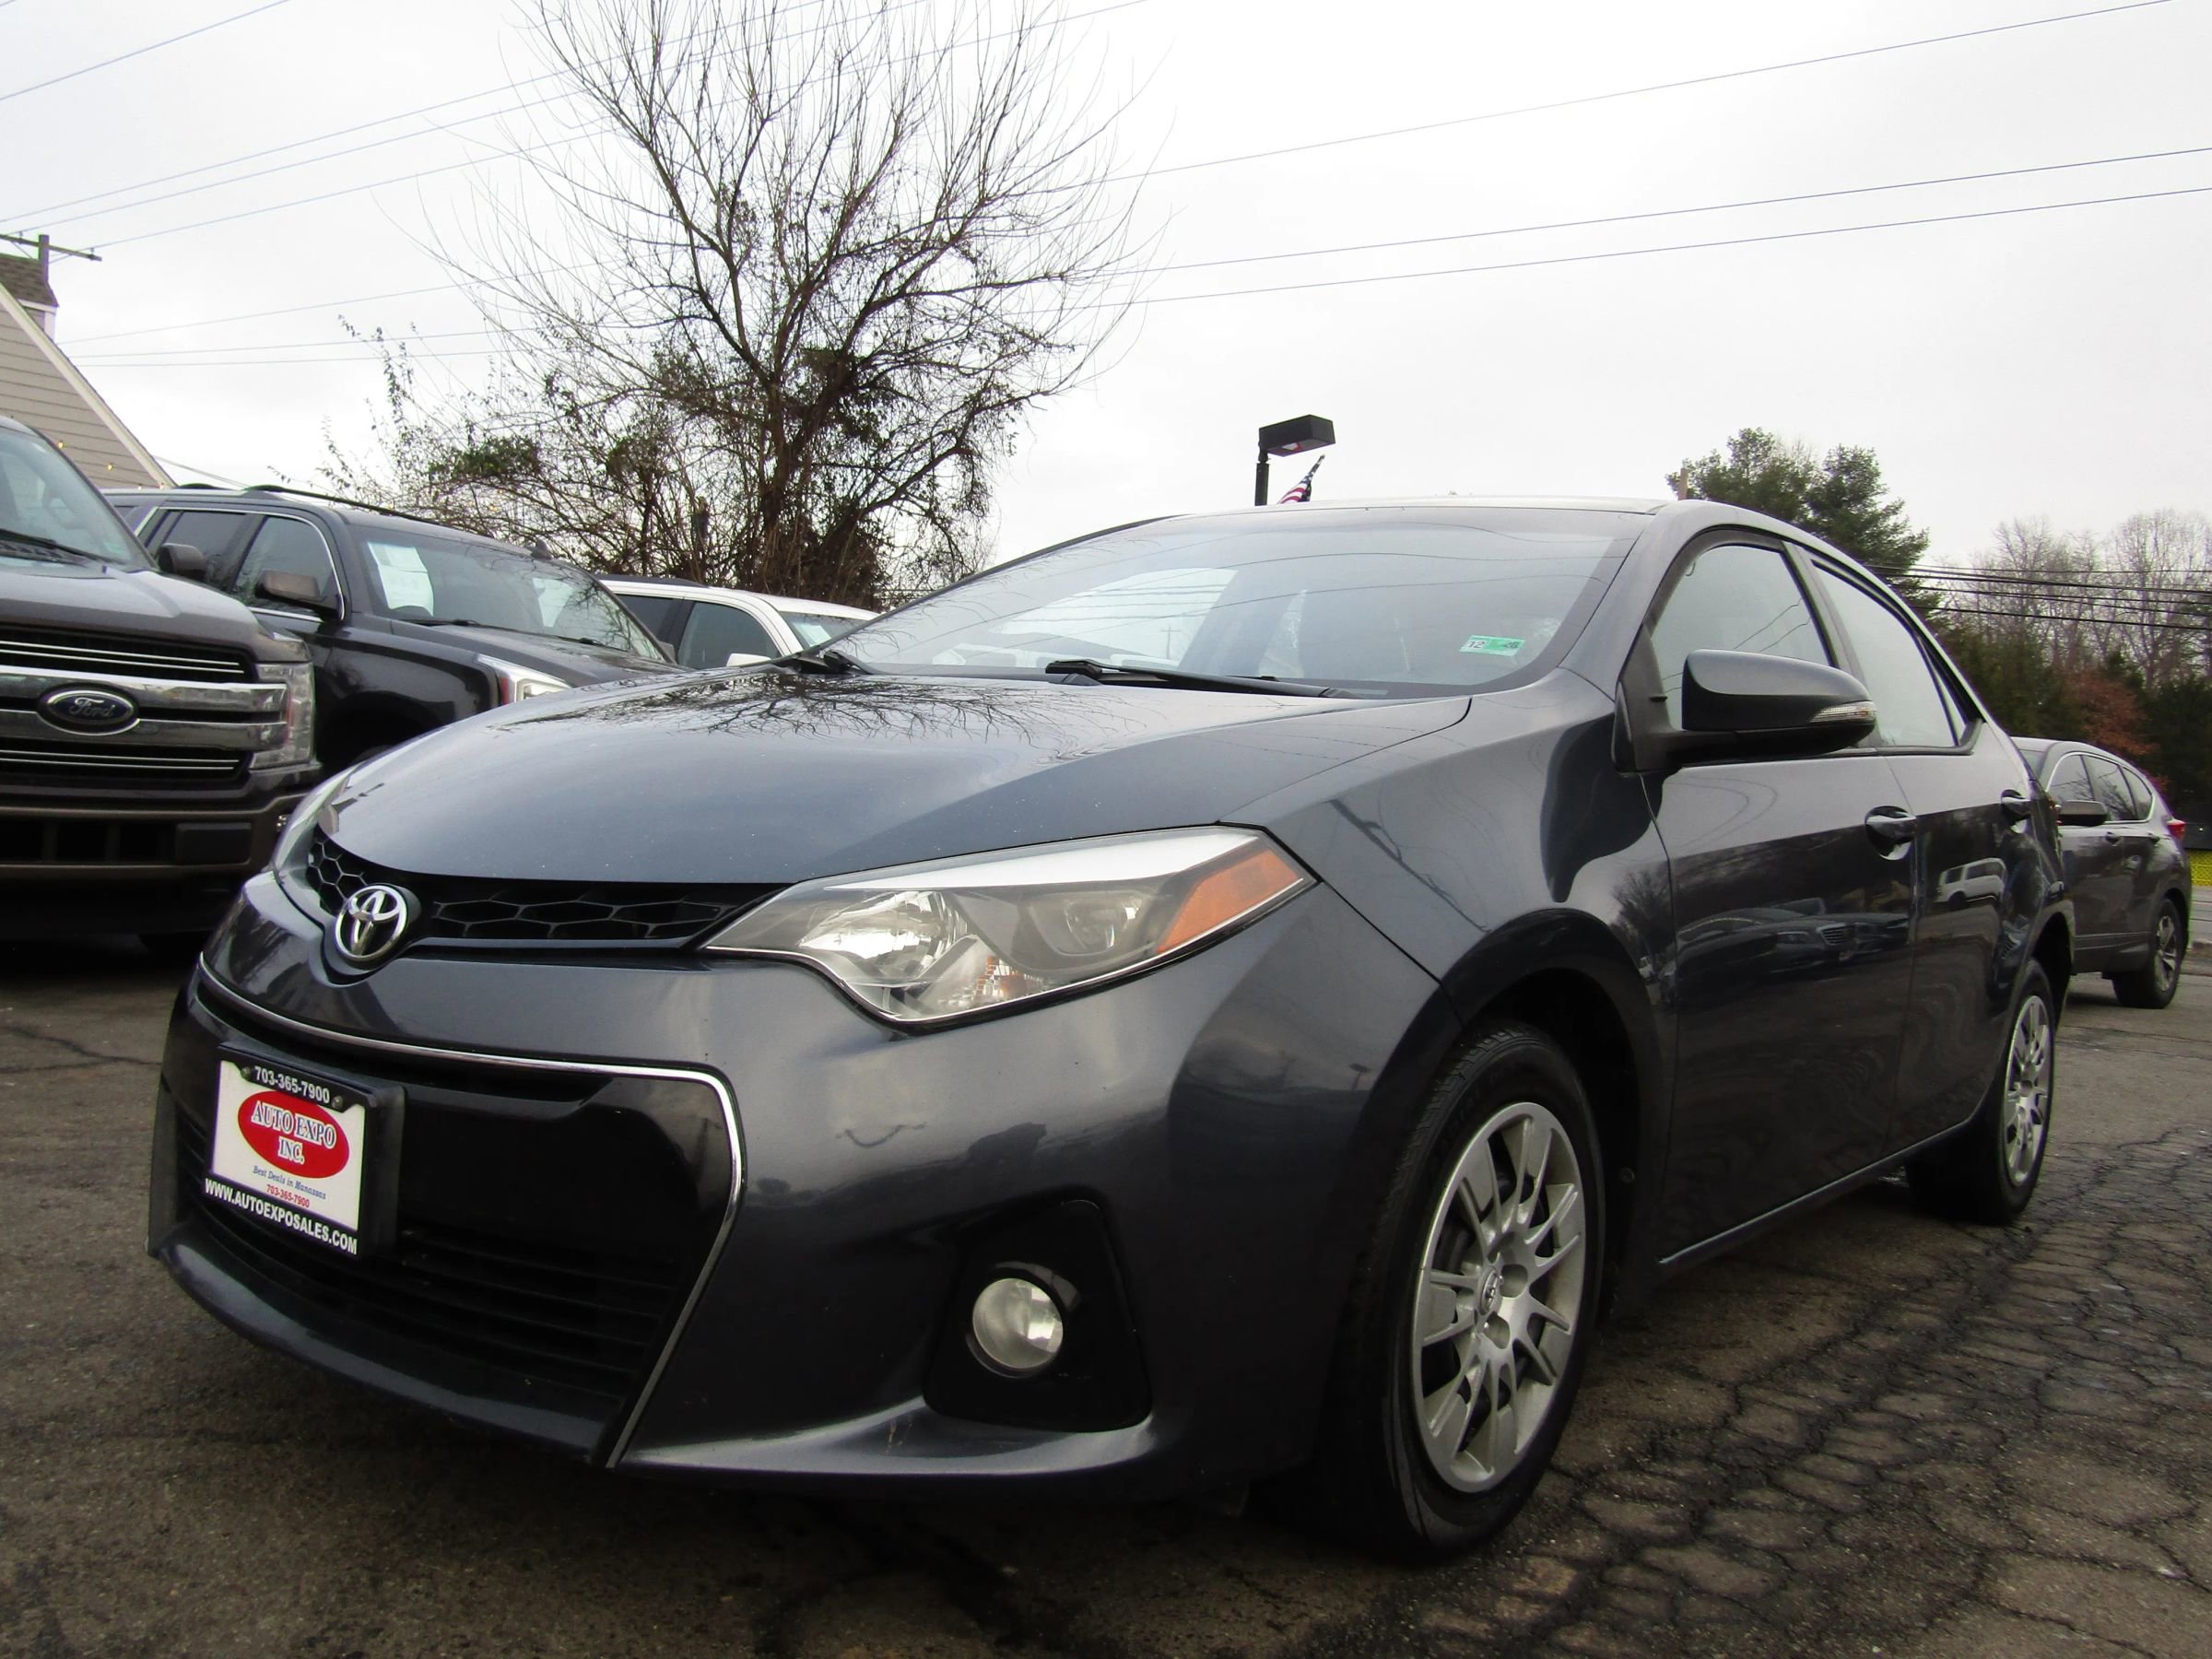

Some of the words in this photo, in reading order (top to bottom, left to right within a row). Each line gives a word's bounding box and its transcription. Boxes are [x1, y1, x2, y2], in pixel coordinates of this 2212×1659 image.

[68, 697, 115, 718] Ford
[253, 1065, 330, 1103] 703-365-7900
[252, 1101, 294, 1136] AUTO
[295, 1113, 336, 1148] EXPO
[278, 1136, 304, 1164] INC.
[253, 1166, 266, 1178] Best
[268, 1171, 286, 1184] Deals
[287, 1177, 293, 1187] in
[266, 1184, 310, 1208] 703-365-7900
[205, 1178, 357, 1254] WWW.AUTOEXPOSALES.COM
